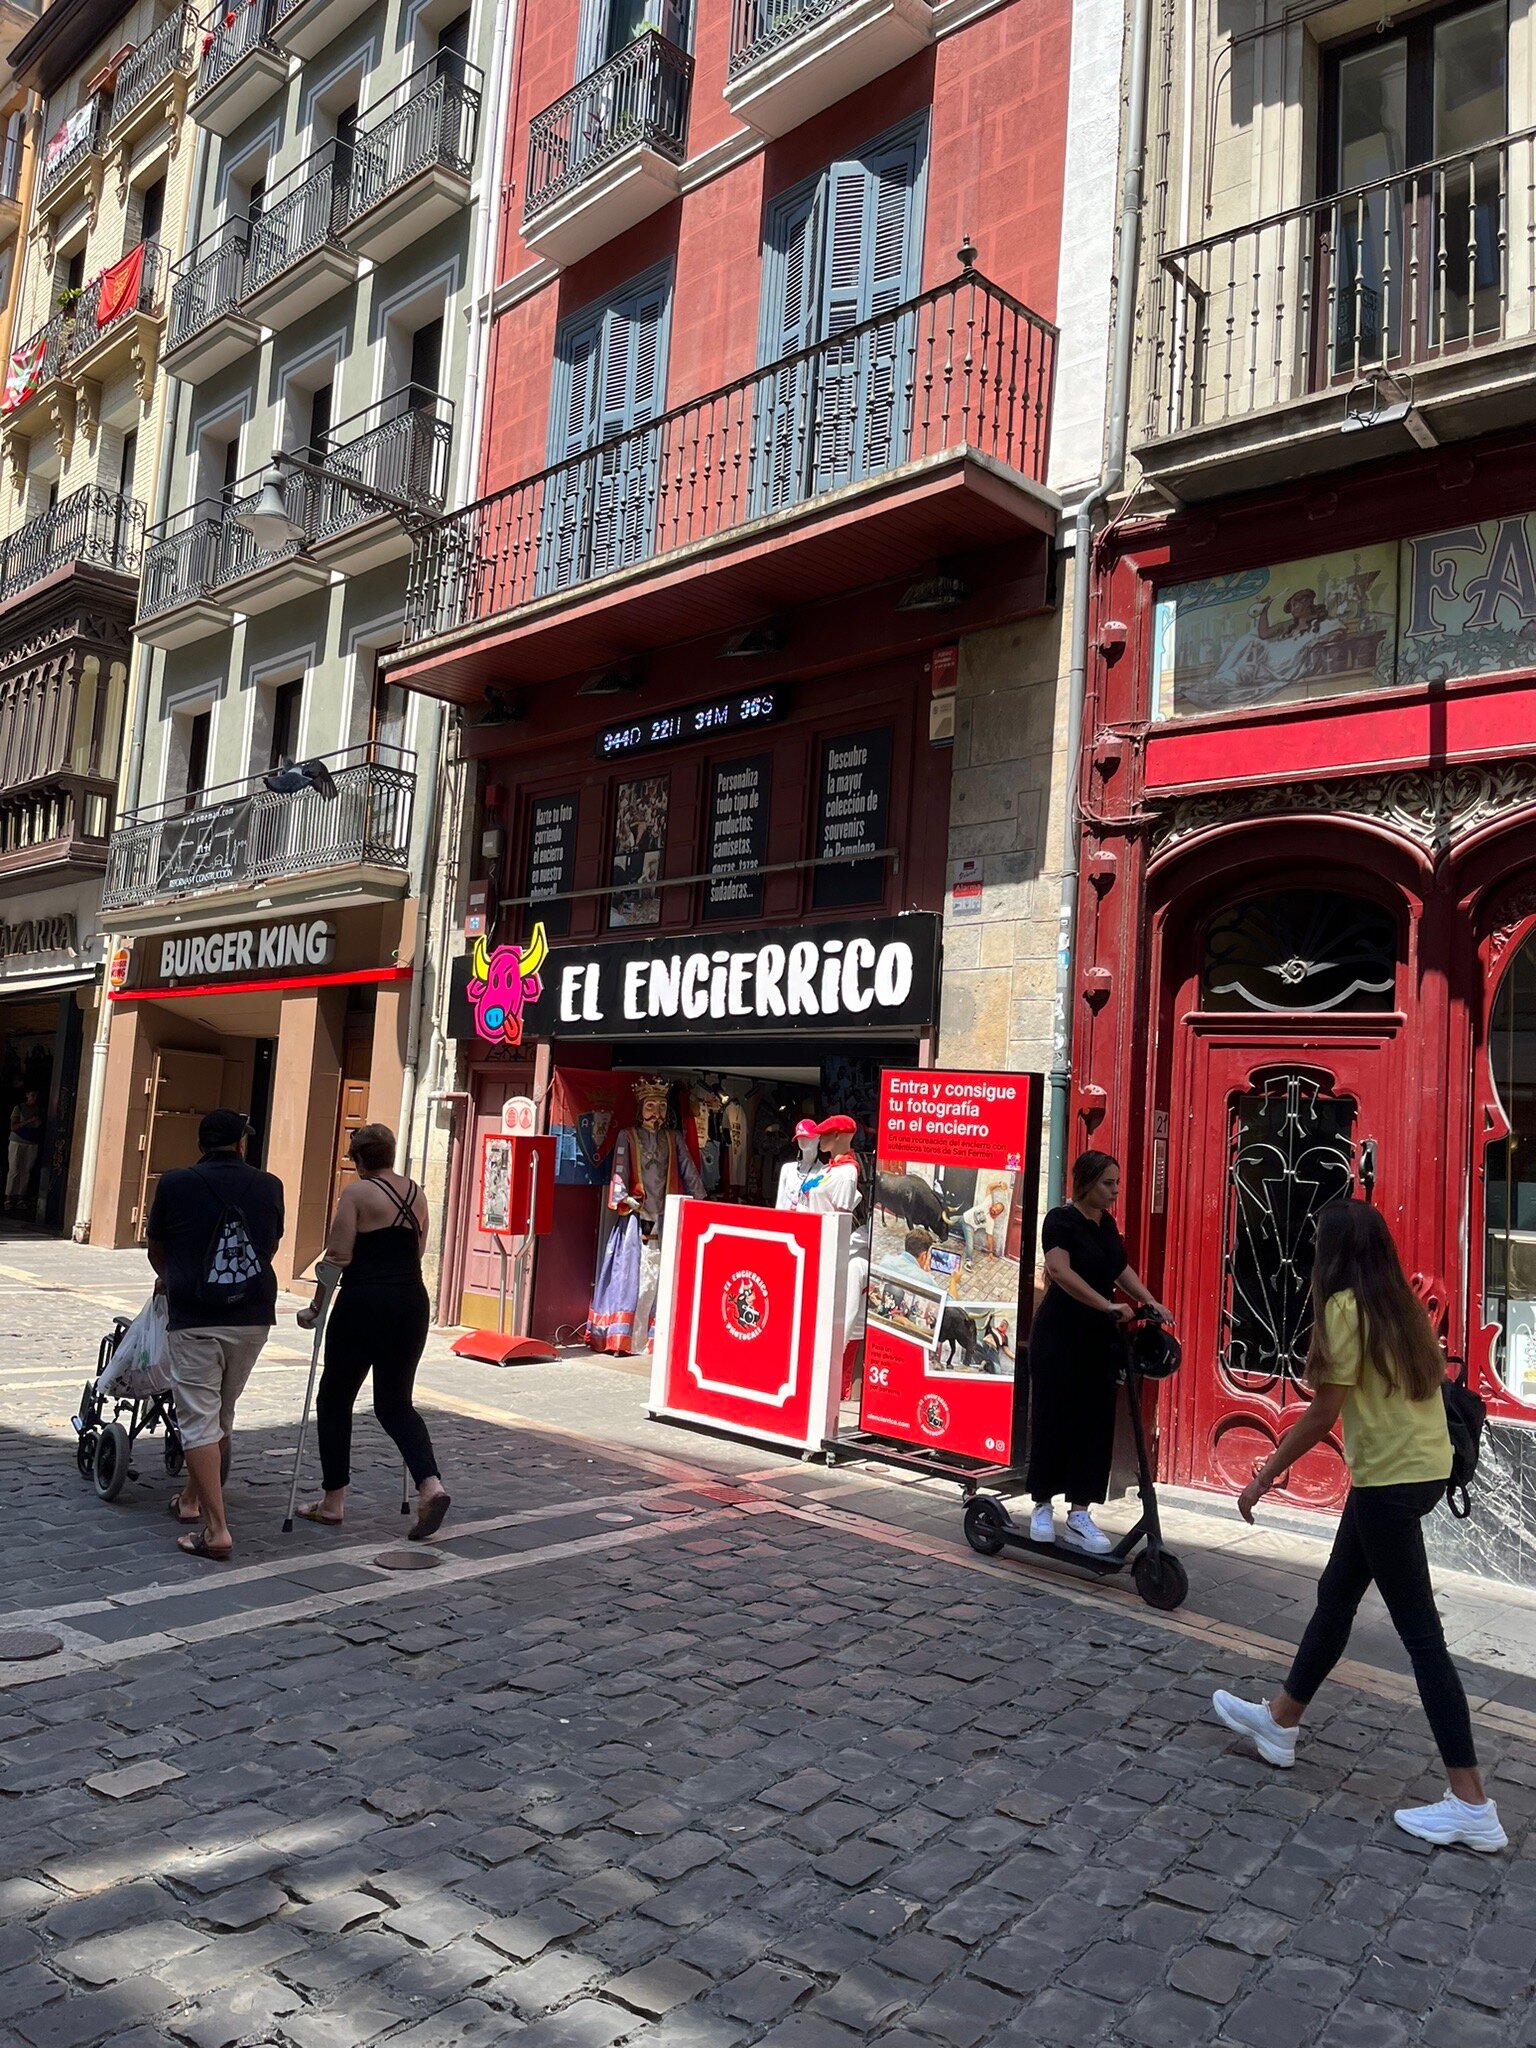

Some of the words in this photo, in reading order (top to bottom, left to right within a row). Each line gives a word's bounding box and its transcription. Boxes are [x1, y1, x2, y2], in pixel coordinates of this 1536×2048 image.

[828, 745, 867, 771] Descubre
[717, 767, 759, 793] Personaliza
[826, 773, 835, 795] la
[836, 772, 862, 796] mayor
[716, 793, 733, 815] todo
[734, 792, 749, 816] tipo
[749, 788, 759, 809] de
[825, 792, 865, 818] colección
[867, 789, 878, 812] de
[536, 808, 552, 826] Hazte
[552, 808, 560, 823] tu
[560, 804, 572, 822] foto
[535, 824, 562, 845] corriendo
[714, 814, 754, 841] productos:
[824, 817, 865, 841] souvenirs
[533, 846, 540, 864] el
[540, 845, 564, 864] encierro
[713, 837, 752, 859] camisetas,
[532, 870, 539, 884] en
[540, 866, 562, 883] nuestro
[160, 930, 253, 978] BURGER
[257, 920, 329, 968] KING
[111, 967, 126, 978] KING
[560, 962, 604, 1022] EL
[890, 1078, 929, 1095] Entra
[932, 1083, 942, 1098] y
[945, 1083, 1017, 1102] consigue
[889, 1097, 903, 1112] tu
[907, 1098, 980, 1118] fotografía
[888, 1118, 905, 1131] en
[909, 1117, 922, 1132] el
[926, 1119, 989, 1137] encierro
[1157, 1115, 1167, 1133] 21
[888, 1134, 898, 1142] En
[898, 1136, 911, 1144] una
[912, 1135, 947, 1146] recreación
[949, 1138, 960, 1147] del
[961, 1140, 991, 1150] encierro
[992, 1143, 1006, 1151] con
[888, 1143, 922, 1153] auténticos
[924, 1146, 941, 1155] toros
[942, 1147, 951, 1155] de
[952, 1148, 967, 1157] San
[967, 1149, 993, 1158] Fermín
[869, 1366, 890, 1386] 3€
